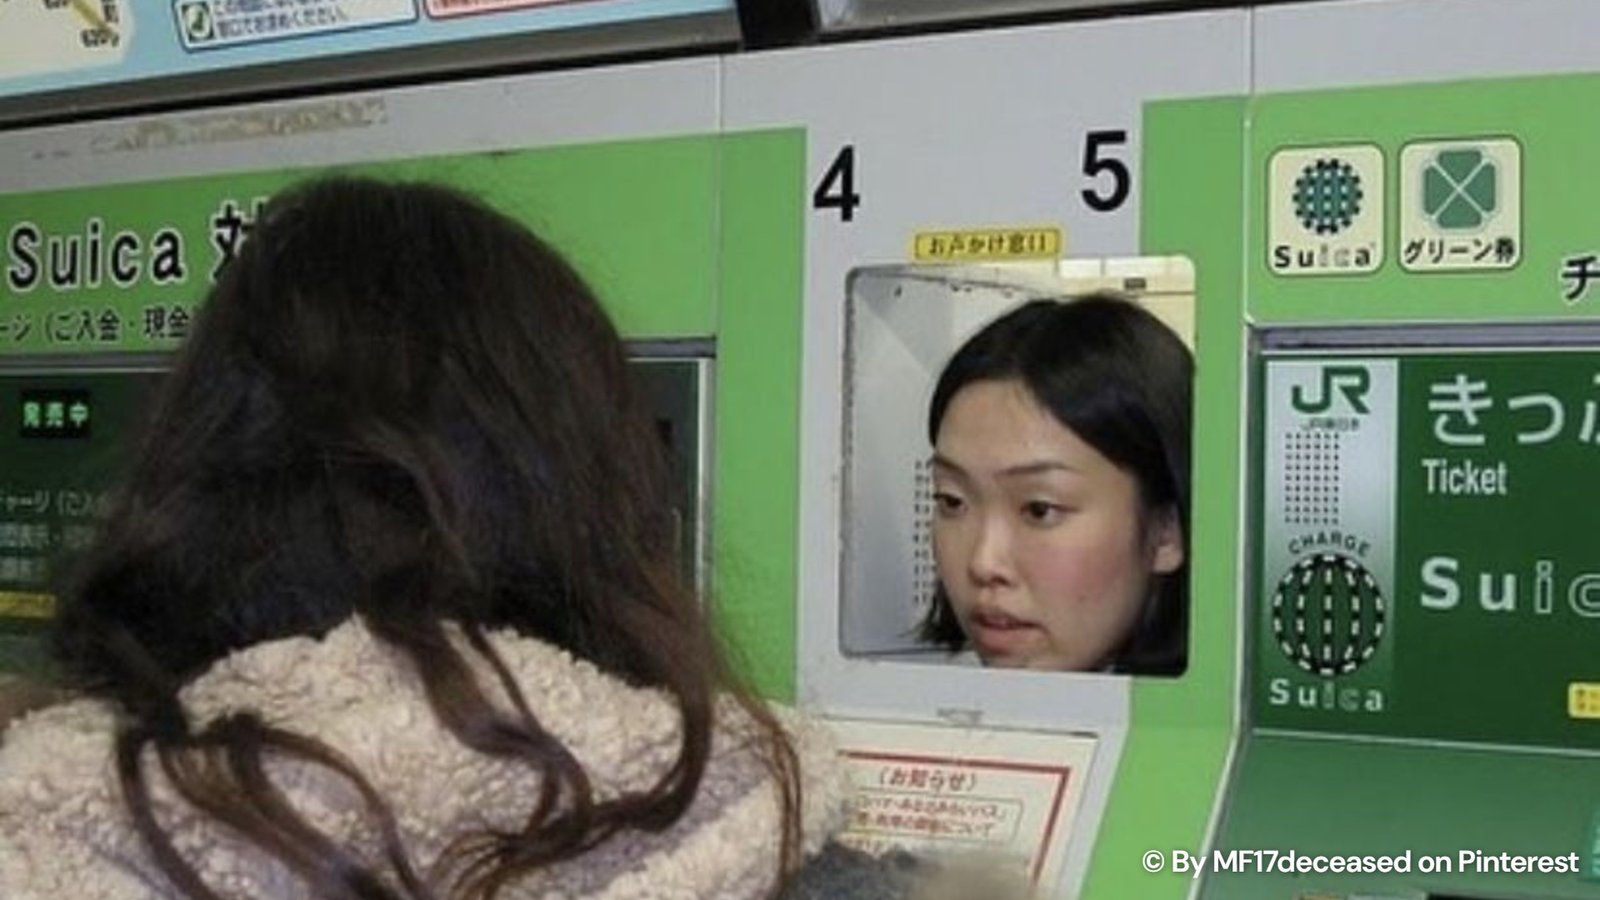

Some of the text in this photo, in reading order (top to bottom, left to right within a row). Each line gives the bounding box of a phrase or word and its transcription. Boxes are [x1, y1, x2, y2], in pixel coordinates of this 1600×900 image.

[813, 144, 860, 221] 4
[1081, 130, 1131, 211] 5
[9, 218, 183, 288] Suica
[1273, 243, 1371, 268] Suica
[1403, 236, 1516, 264] グリーン券
[1291, 365, 1371, 414] JR
[22, 401, 90, 429] 発売中
[1421, 457, 1507, 496] Ticket
[1287, 532, 1372, 557] CHARGE
[1268, 678, 1384, 713] Suica
